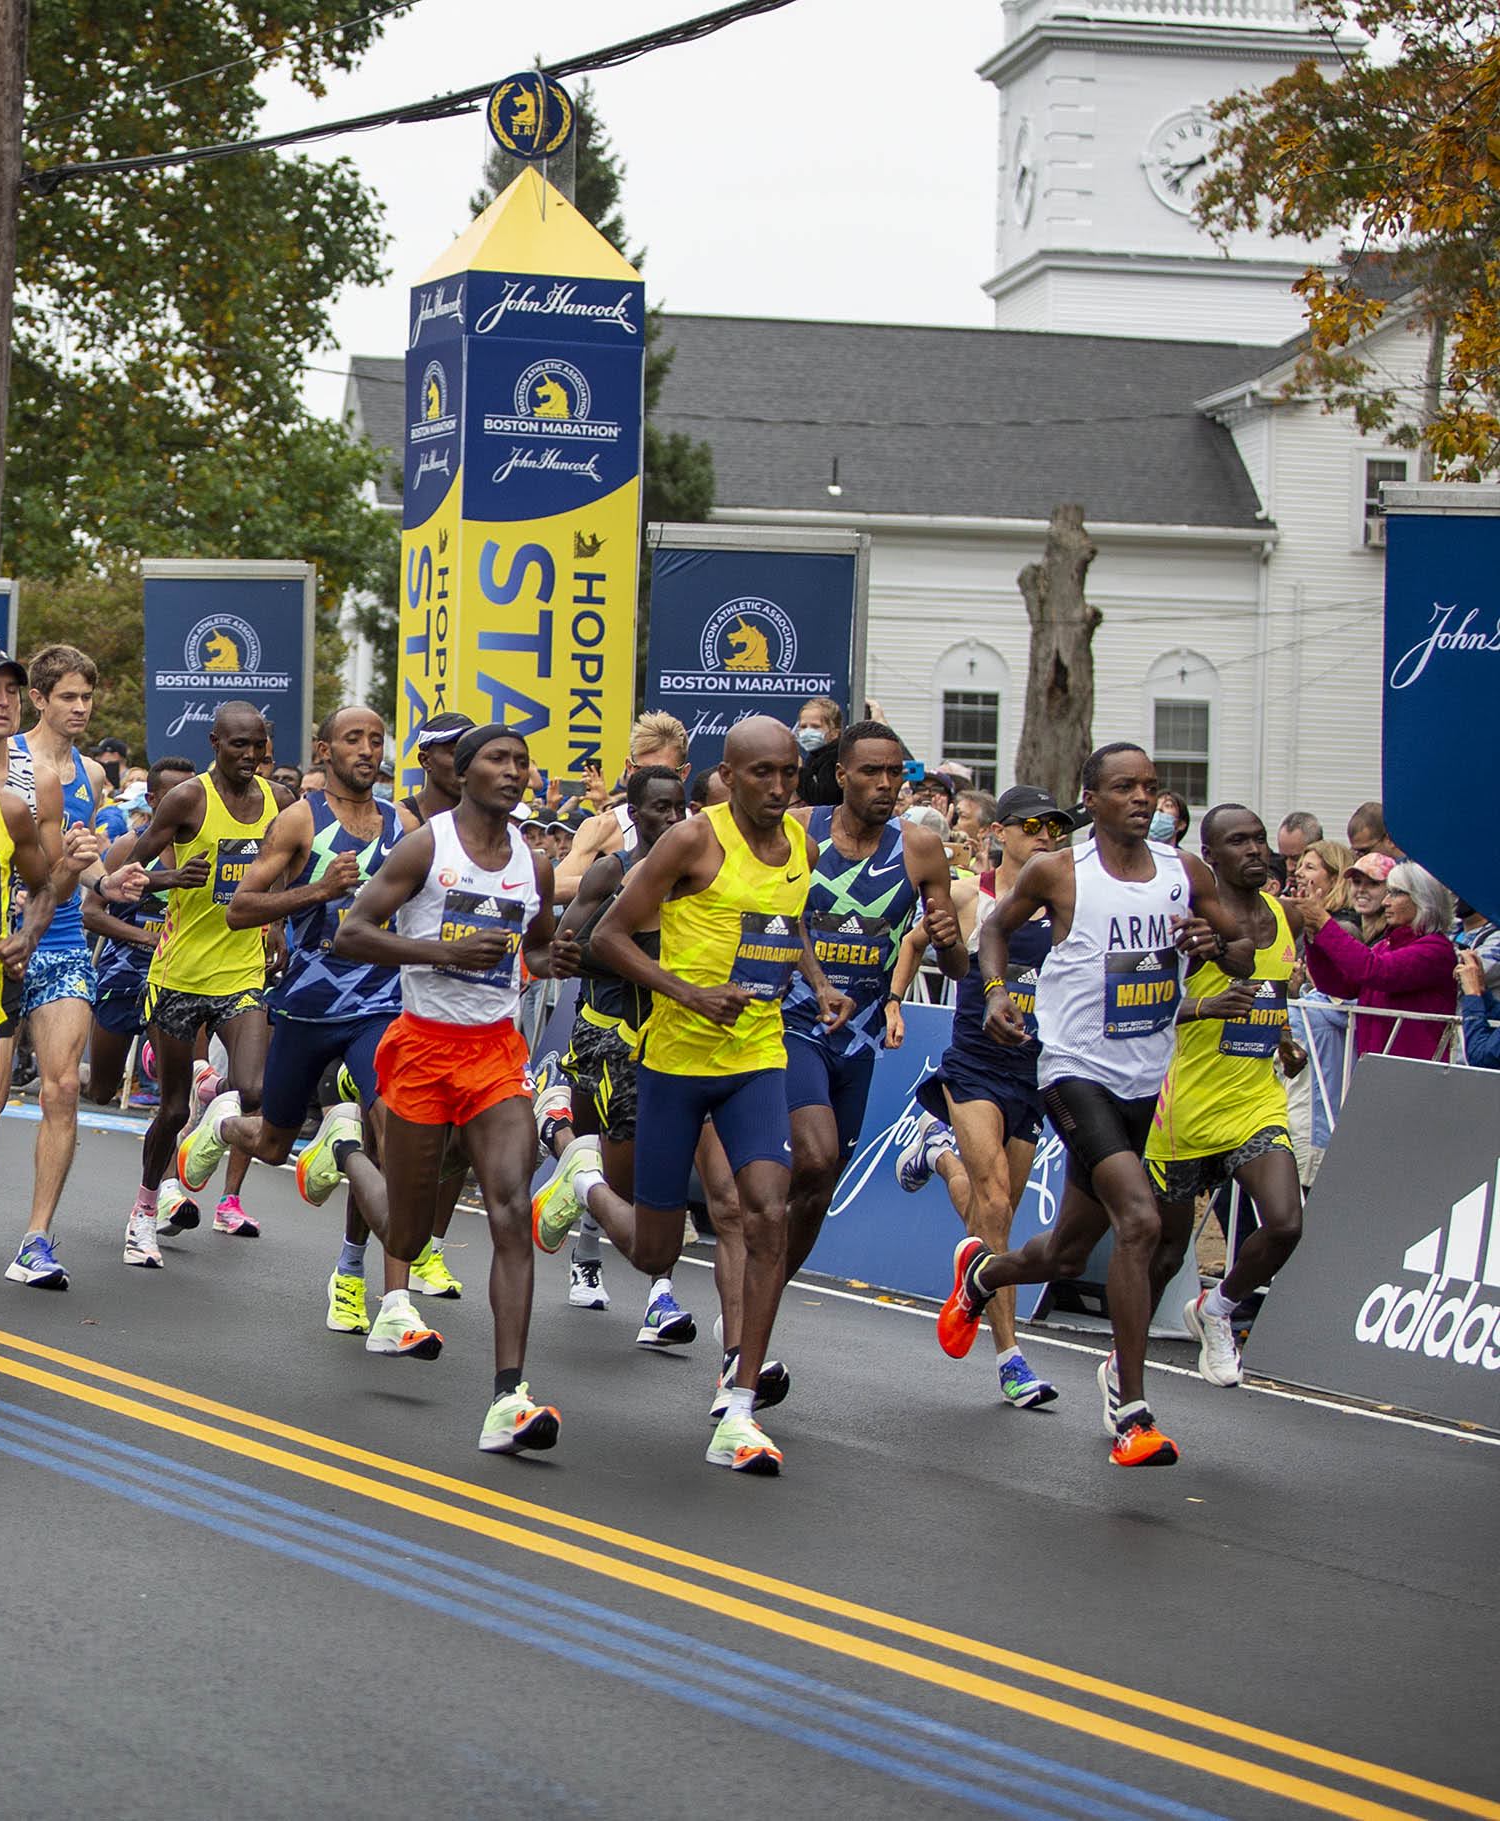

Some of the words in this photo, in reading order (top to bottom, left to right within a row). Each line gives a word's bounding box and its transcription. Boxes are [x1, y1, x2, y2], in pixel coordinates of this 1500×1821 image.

[475, 280, 541, 334] John
[539, 282, 637, 334] Hancock
[518, 377, 529, 413] BOSTON
[527, 363, 563, 381] ATHLETIC
[563, 365, 588, 418] ASSOCIATION
[483, 419, 539, 433] BOSTON
[542, 422, 618, 438] MARATHON
[492, 446, 538, 483] John
[537, 448, 602, 482] Hancock
[189, 632, 199, 668] BOSTON
[196, 617, 232, 635] ATHLETIC
[232, 621, 258, 669] ASSOCIATION
[704, 622, 719, 666] BOSTON
[716, 601, 762, 624] ATHLETIC
[762, 605, 793, 669] ASSOCIATION
[1390, 602, 1488, 690] John
[476, 539, 555, 778] STA
[155, 675, 210, 687] BOSTON
[213, 676, 289, 688] MARATHON
[659, 675, 730, 690] BOSTON
[735, 677, 831, 692] MARATHON
[166, 701, 212, 737] John
[687, 709, 729, 747] John
[474, 907, 502, 918] adidas
[764, 927, 789, 936] adidas
[838, 926, 863, 934] adidas
[814, 940, 880, 966] DEBELA
[1136, 962, 1162, 971] adidas
[1116, 979, 1175, 1008] MAIYO
